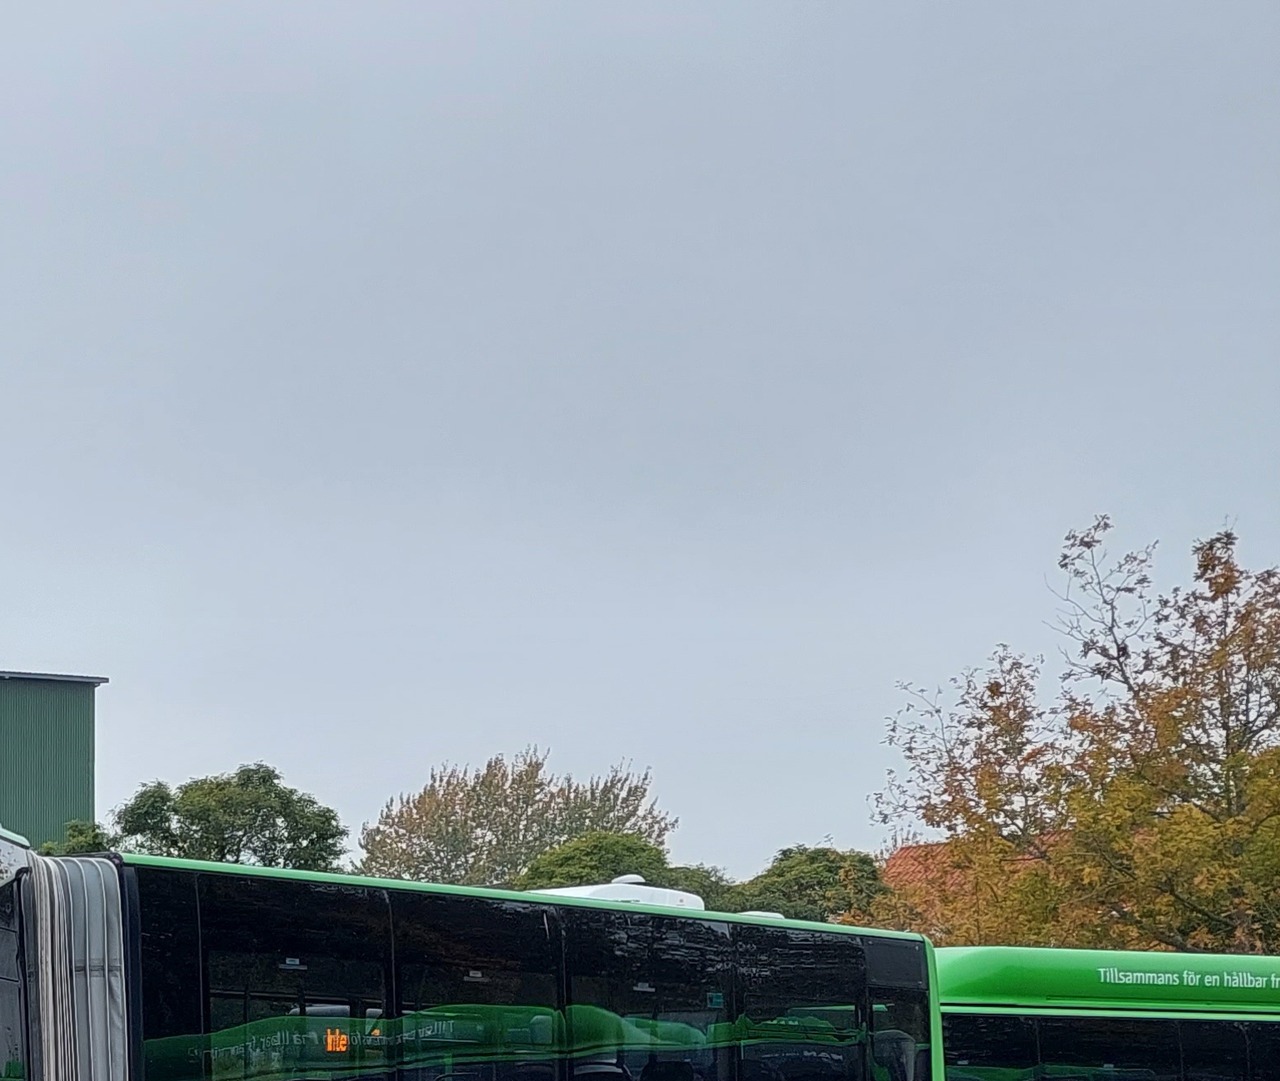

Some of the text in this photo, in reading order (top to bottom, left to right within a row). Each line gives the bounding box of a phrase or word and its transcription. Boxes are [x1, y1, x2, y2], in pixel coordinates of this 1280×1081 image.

[1097, 967, 1180, 986] Tillsammans
[1183, 970, 1201, 986] för
[1204, 974, 1220, 987] en
[1223, 971, 1268, 989] hållbar
